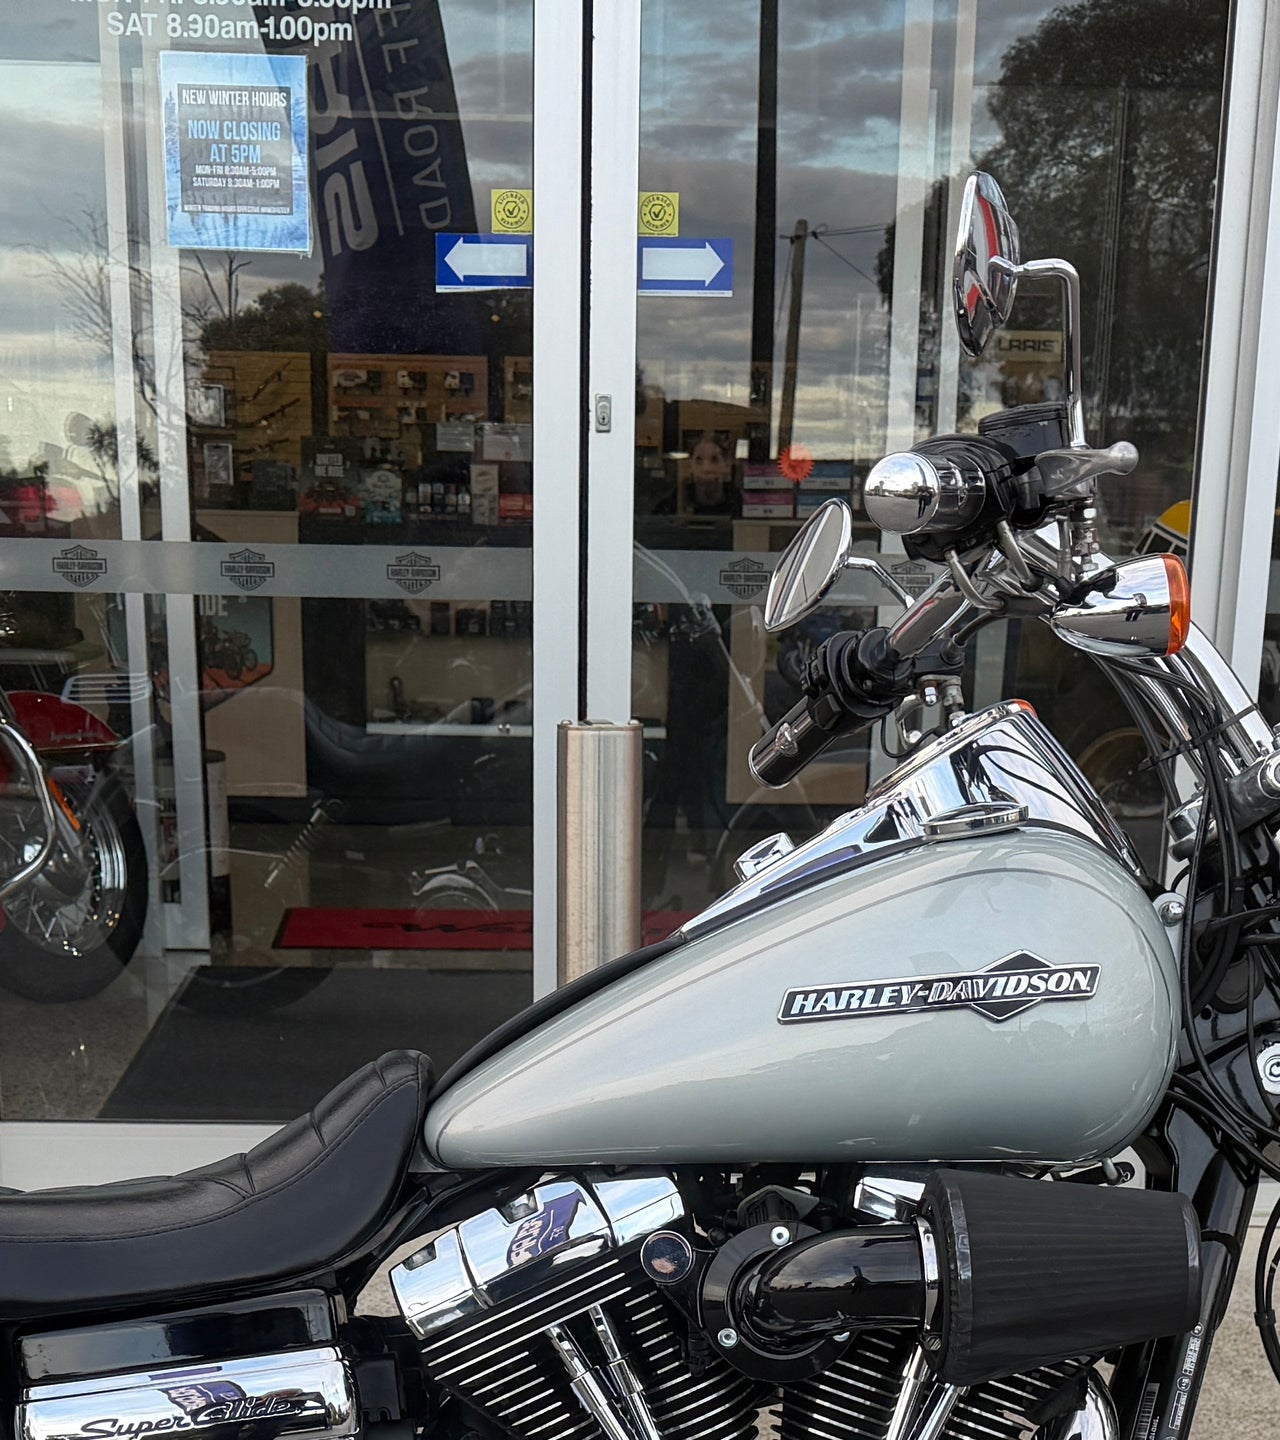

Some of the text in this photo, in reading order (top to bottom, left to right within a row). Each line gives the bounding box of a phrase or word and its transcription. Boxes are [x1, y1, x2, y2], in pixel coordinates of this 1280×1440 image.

[107, 12, 158, 36] SAT
[182, 89, 287, 107] NEW WINTER HOURS
[187, 120, 281, 141] NOW CLOSING
[210, 144, 261, 163] AT 5PM
[193, 177, 226, 188] SATURDAY
[998, 338, 1056, 352] LARIS
[790, 969, 1092, 1015] HARLEY-DAVIDSON
[192, 1398, 302, 1427] Glide
